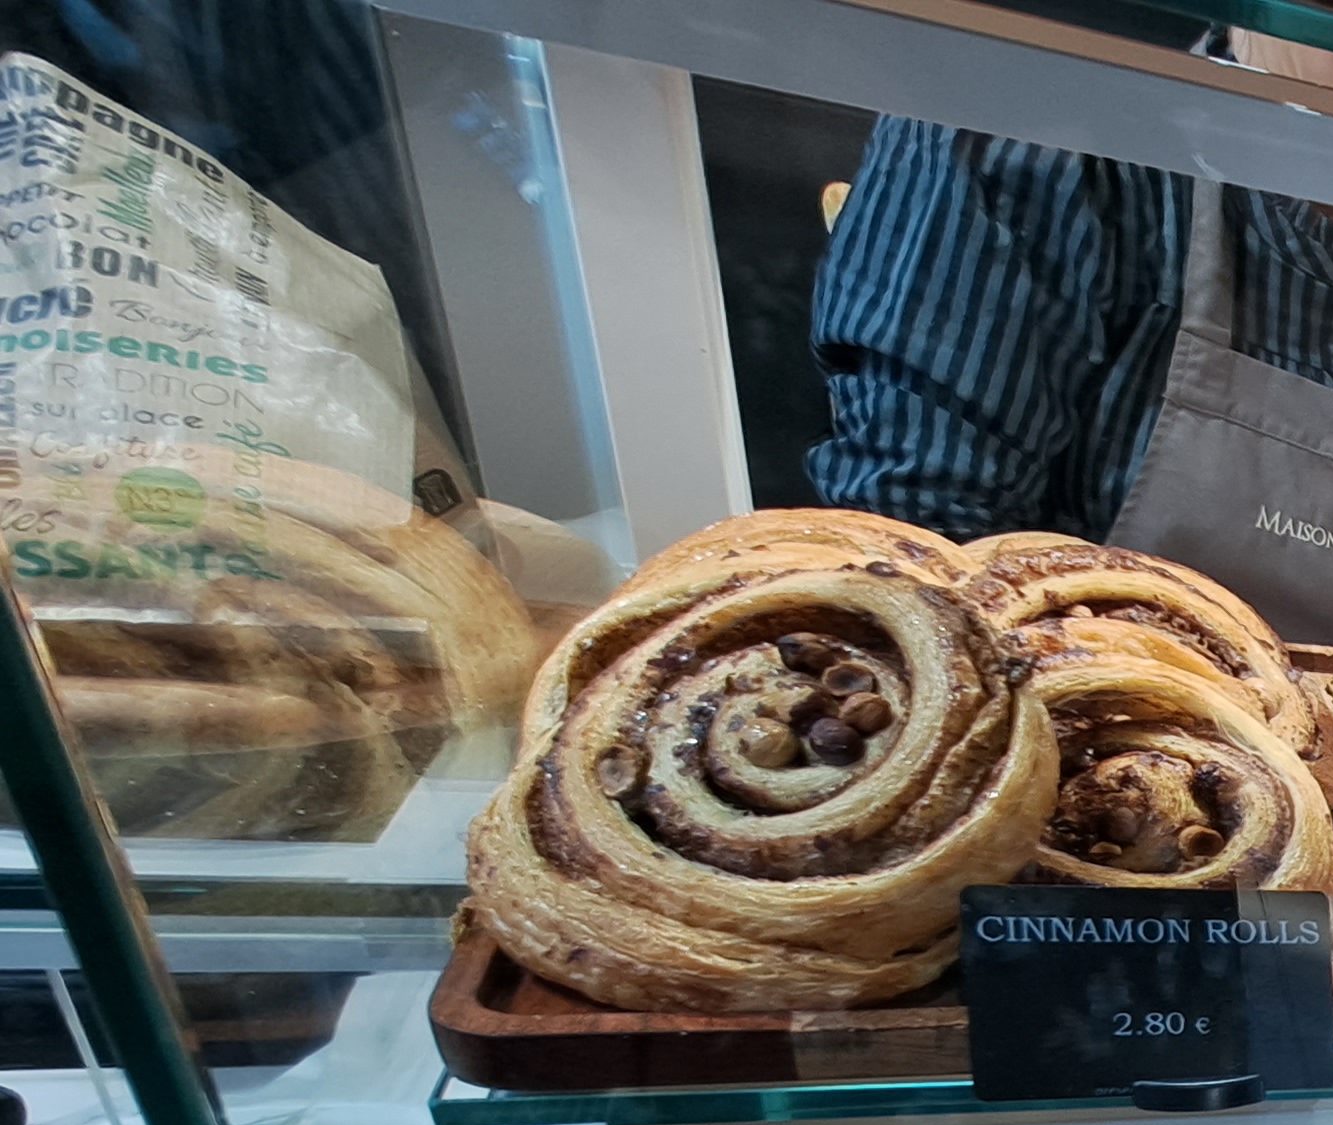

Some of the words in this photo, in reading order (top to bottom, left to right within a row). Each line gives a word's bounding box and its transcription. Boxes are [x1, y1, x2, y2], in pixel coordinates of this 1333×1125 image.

[55, 239, 159, 290] BON
[976, 916, 1191, 943] CINNAMON
[1206, 919, 1321, 944] ROLLS
[1112, 1012, 1186, 1037] 2.80
[1195, 1017, 1212, 1035] €
